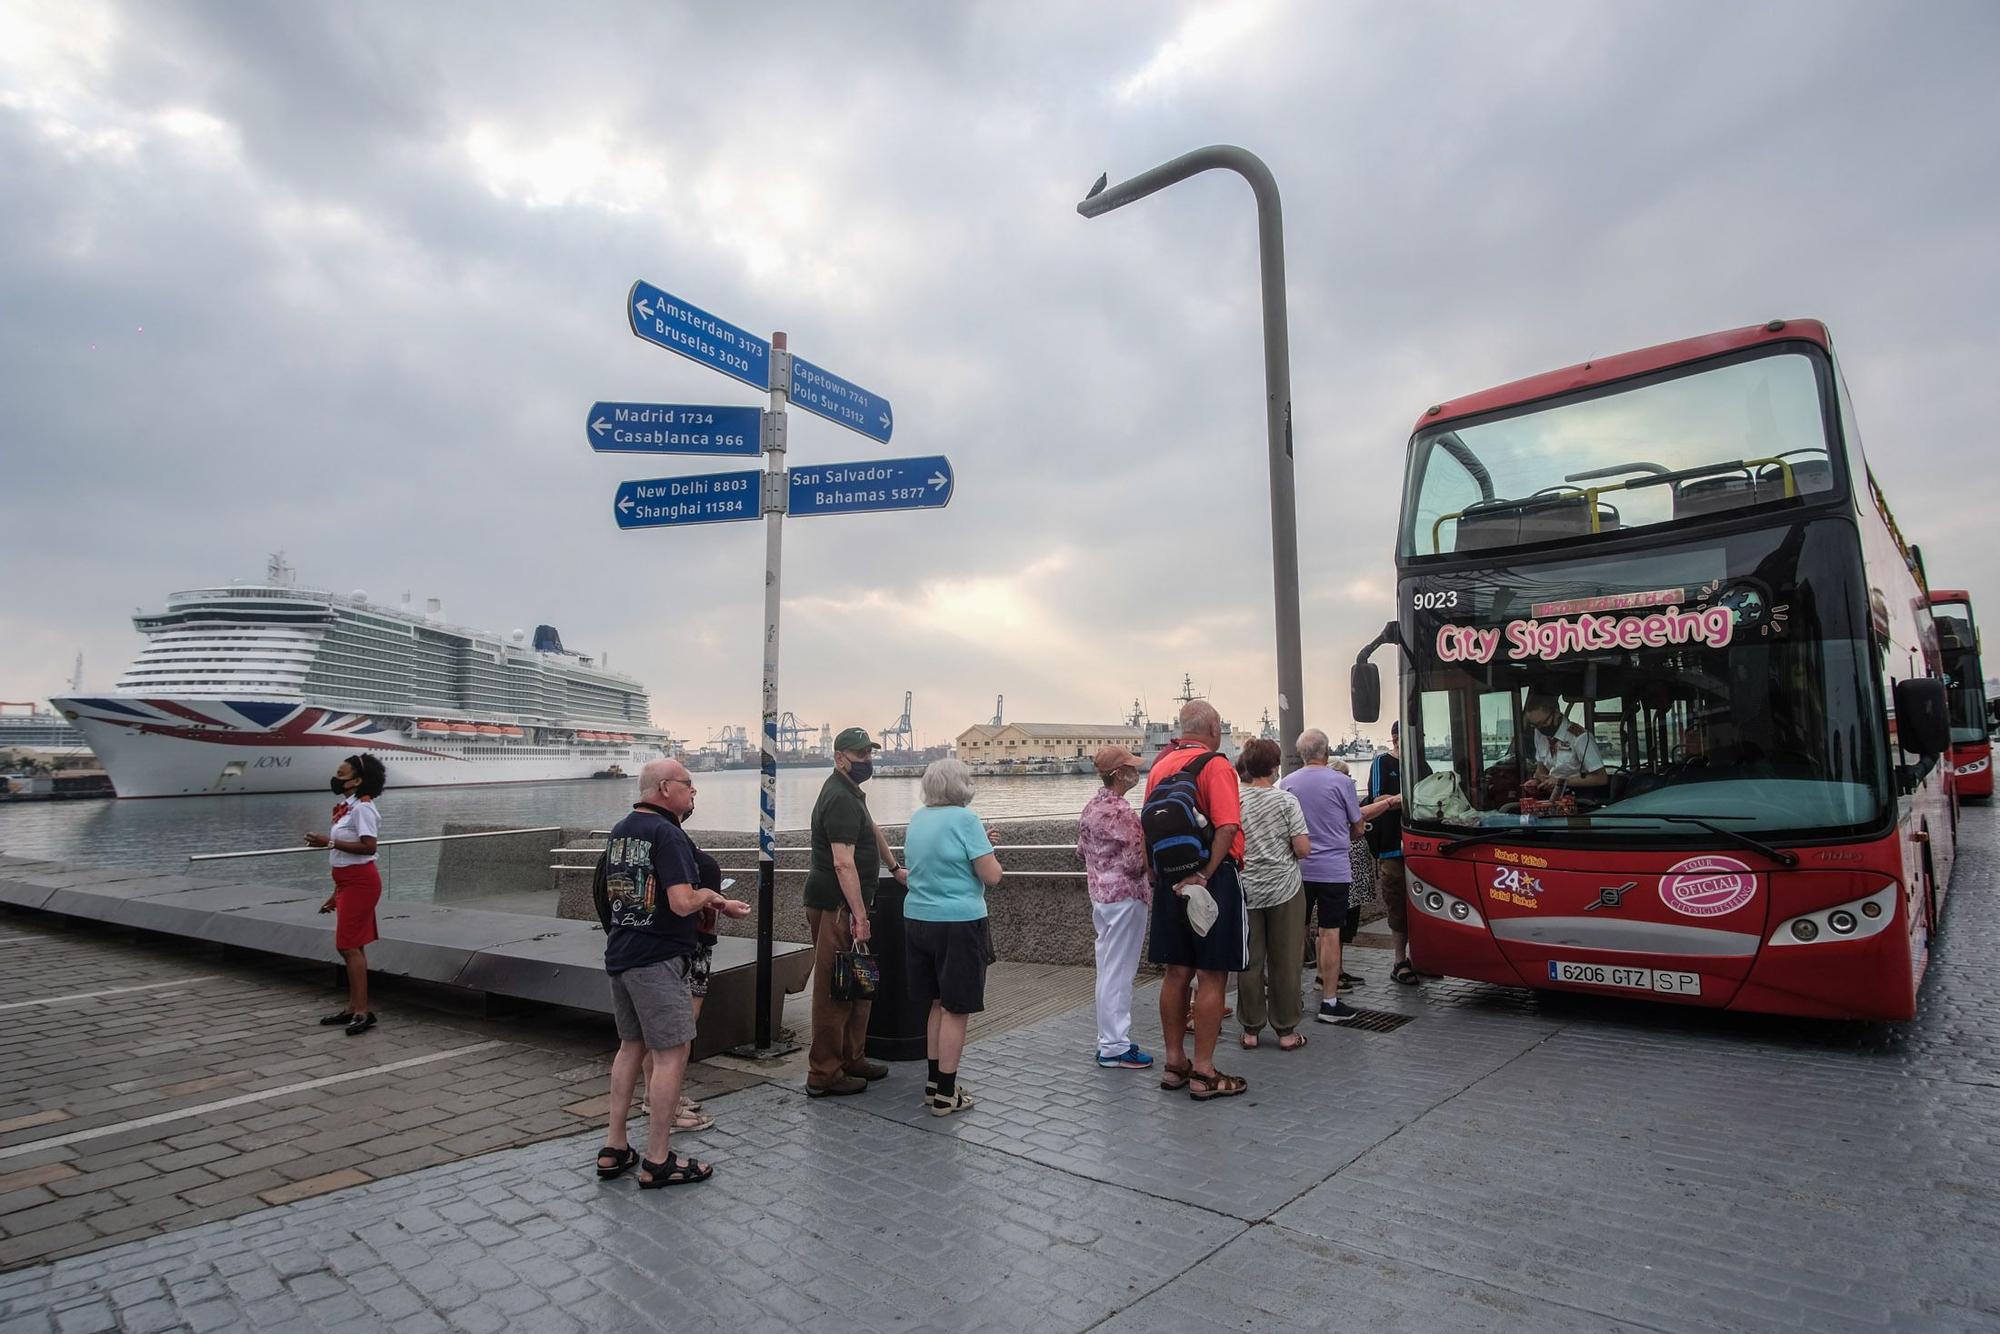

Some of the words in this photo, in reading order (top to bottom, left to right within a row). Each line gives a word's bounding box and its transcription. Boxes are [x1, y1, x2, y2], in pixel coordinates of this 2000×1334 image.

[656, 297, 735, 345] Amsterdam
[738, 338, 763, 358] 3173
[655, 318, 716, 357] Bruselas
[719, 350, 749, 372] 3020
[794, 363, 847, 398] Capetown
[848, 390, 868, 408] 7741
[793, 382, 818, 403] Polo
[820, 395, 840, 412] Sur
[841, 406, 865, 425] 13112
[615, 408, 674, 424] Madrid
[680, 413, 714, 425] 1734
[613, 429, 709, 446] Casablanca
[715, 434, 744, 446] 966
[792, 473, 820, 486] San
[825, 467, 894, 484] Salvador
[636, 486, 667, 499] New
[671, 480, 708, 496] Delhi
[713, 479, 748, 492] 8803
[815, 490, 886, 505] Bahamas
[891, 487, 925, 500] 5877
[635, 501, 701, 519] Shanghai
[705, 500, 743, 513] 11584
[1413, 590, 1458, 610] 9023
[1436, 623, 1501, 663] City
[1505, 606, 1733, 660] Sightseeing
[253, 755, 292, 768] IONA
[1682, 859, 1713, 871] TOUR
[1493, 866, 1520, 893] 24
[1677, 875, 1738, 898] OFICIAL
[1563, 964, 1606, 983] 6206
[1612, 968, 1646, 987] GTZ
